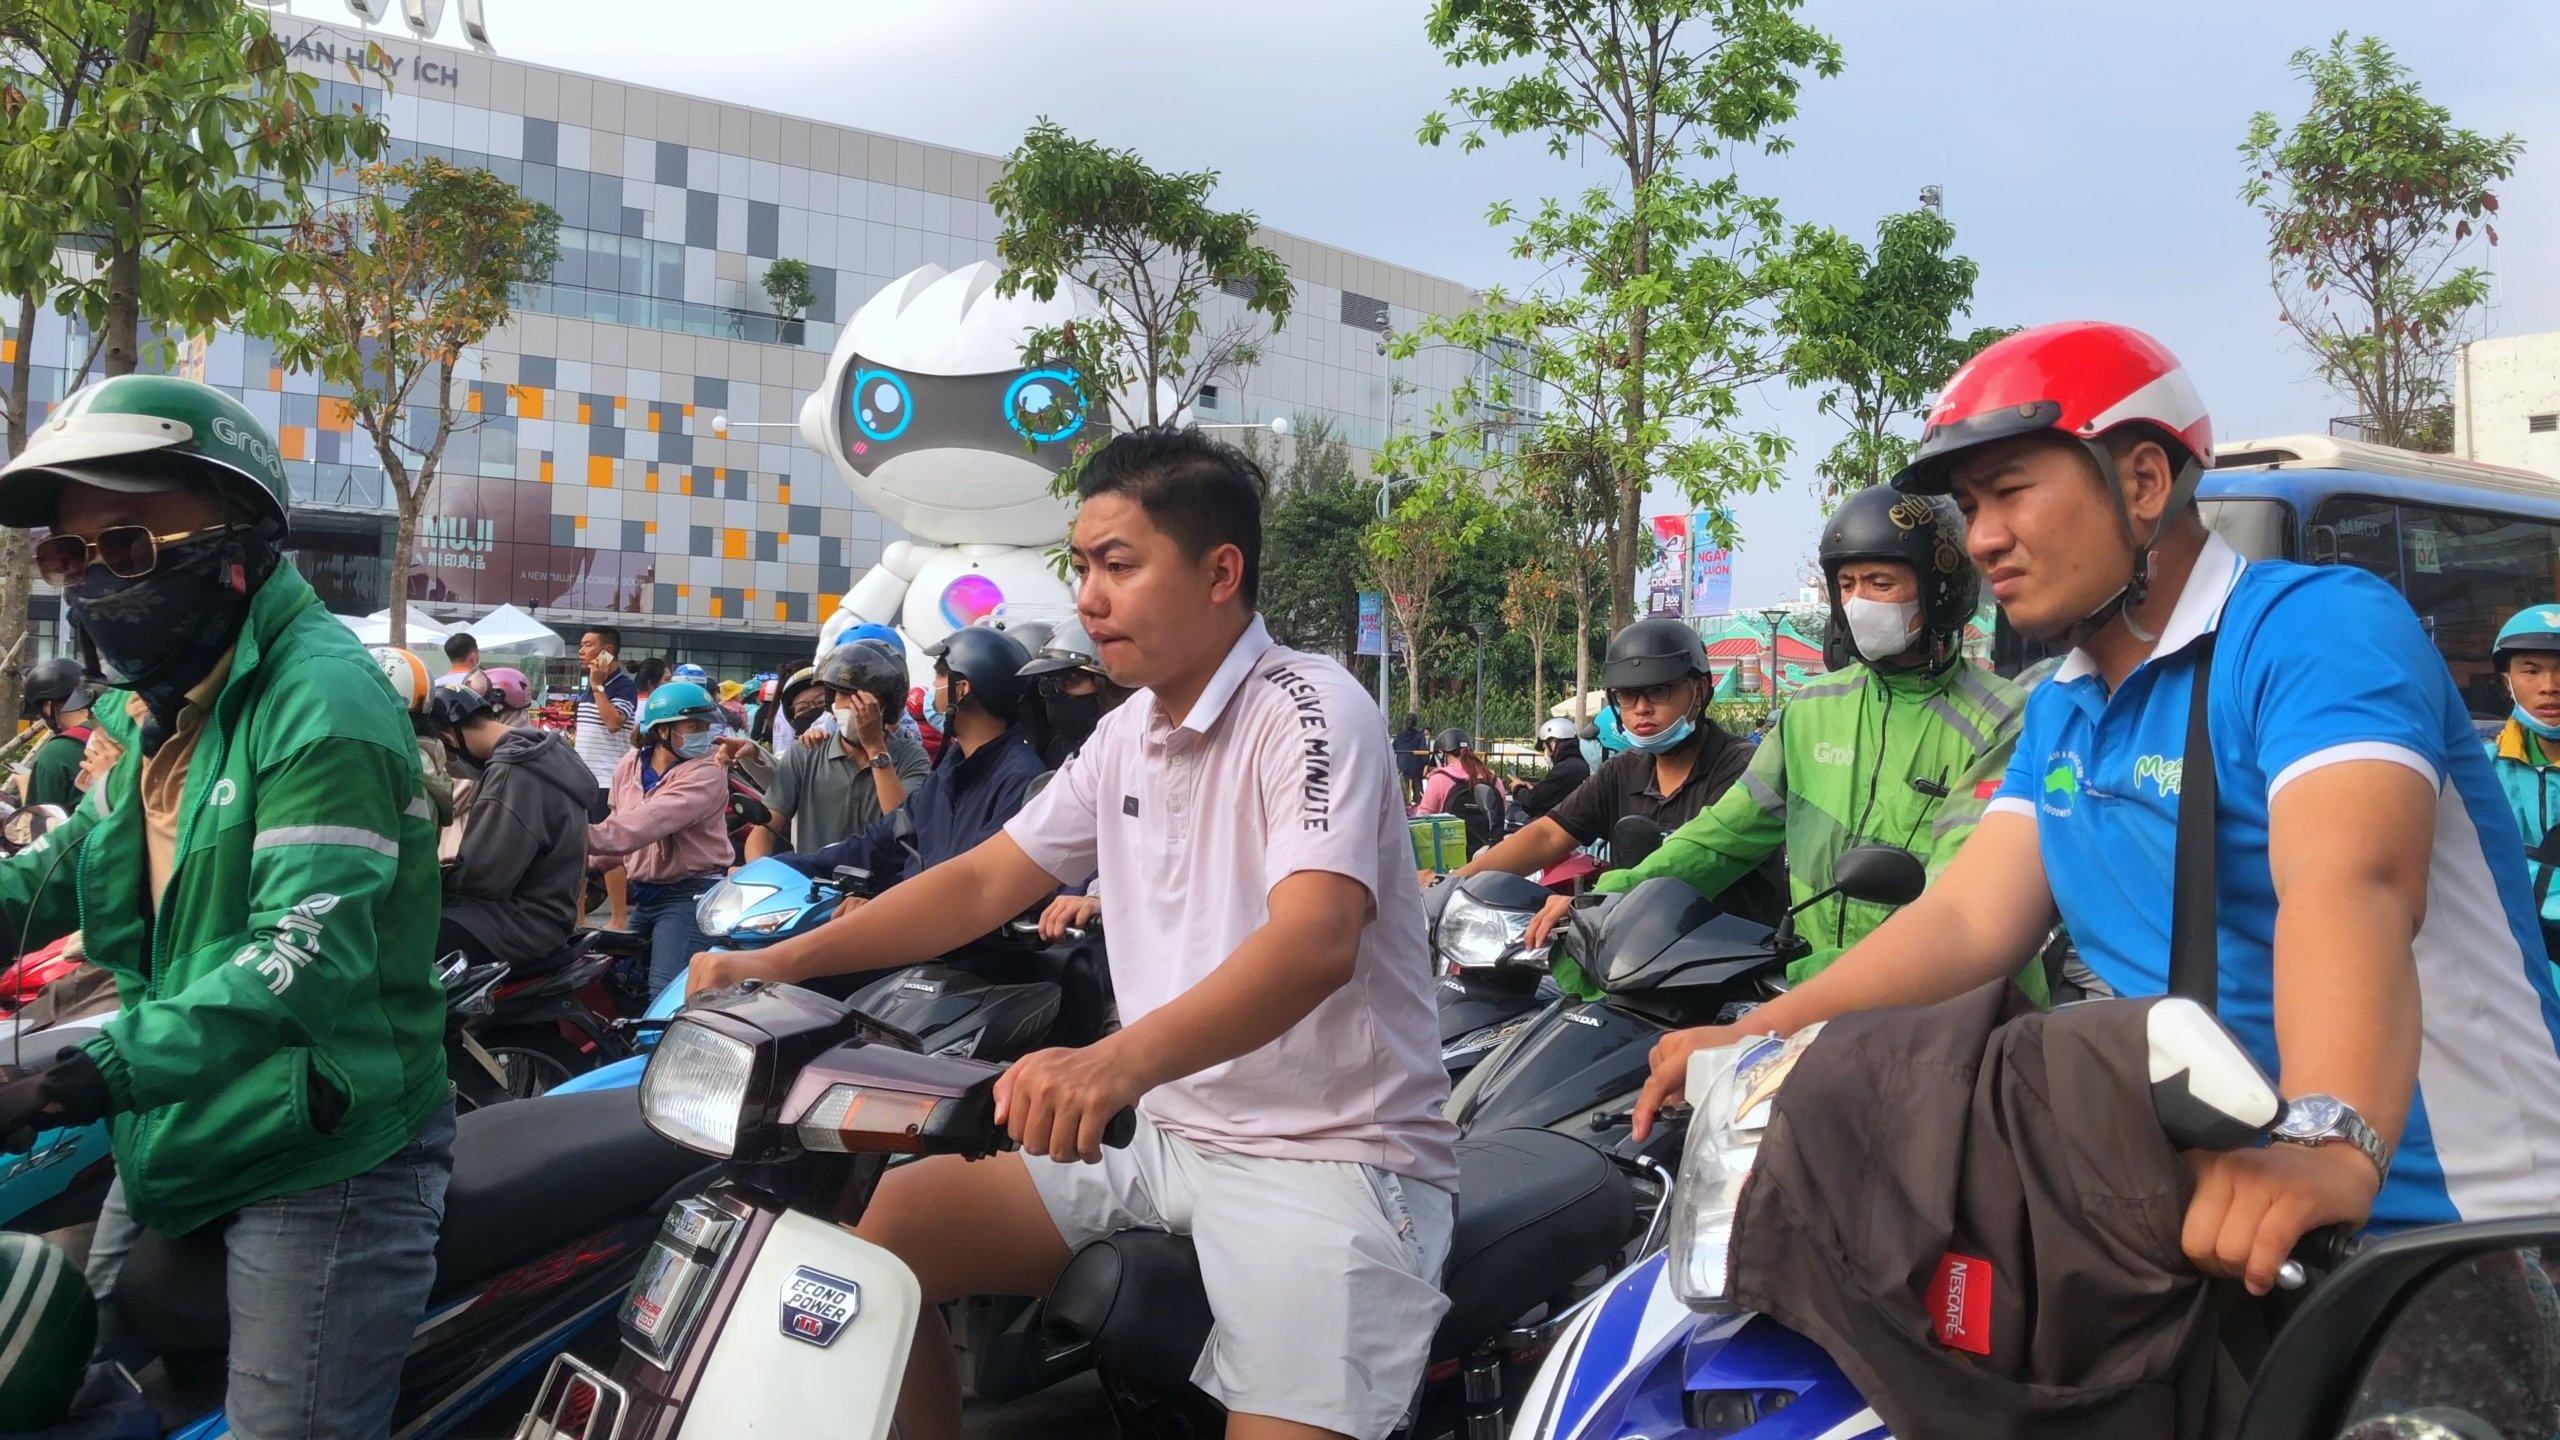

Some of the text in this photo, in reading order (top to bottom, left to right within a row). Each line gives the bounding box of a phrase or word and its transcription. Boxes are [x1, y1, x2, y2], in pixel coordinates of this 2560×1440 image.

[270, 33, 335, 65] HAN
[413, 56, 459, 89] ÍCH
[422, 514, 494, 553] MUJI
[427, 552, 486, 570] 無印良品
[1698, 548, 1729, 563] NGAY
[528, 571, 547, 581] NEW
[1703, 562, 1730, 576] LUÔN
[1664, 595, 1680, 604] 300
[1813, 742, 1855, 767] Grab
[2134, 754, 2184, 790] Mea
[1303, 738, 1330, 832] MINUTE
[903, 982, 934, 993] HONDA
[1442, 980, 1467, 995] NDA
[790, 1279, 847, 1305] ECONO
[1945, 1261, 1968, 1338] NESCAFÉ
[787, 1293, 847, 1322] POWER
